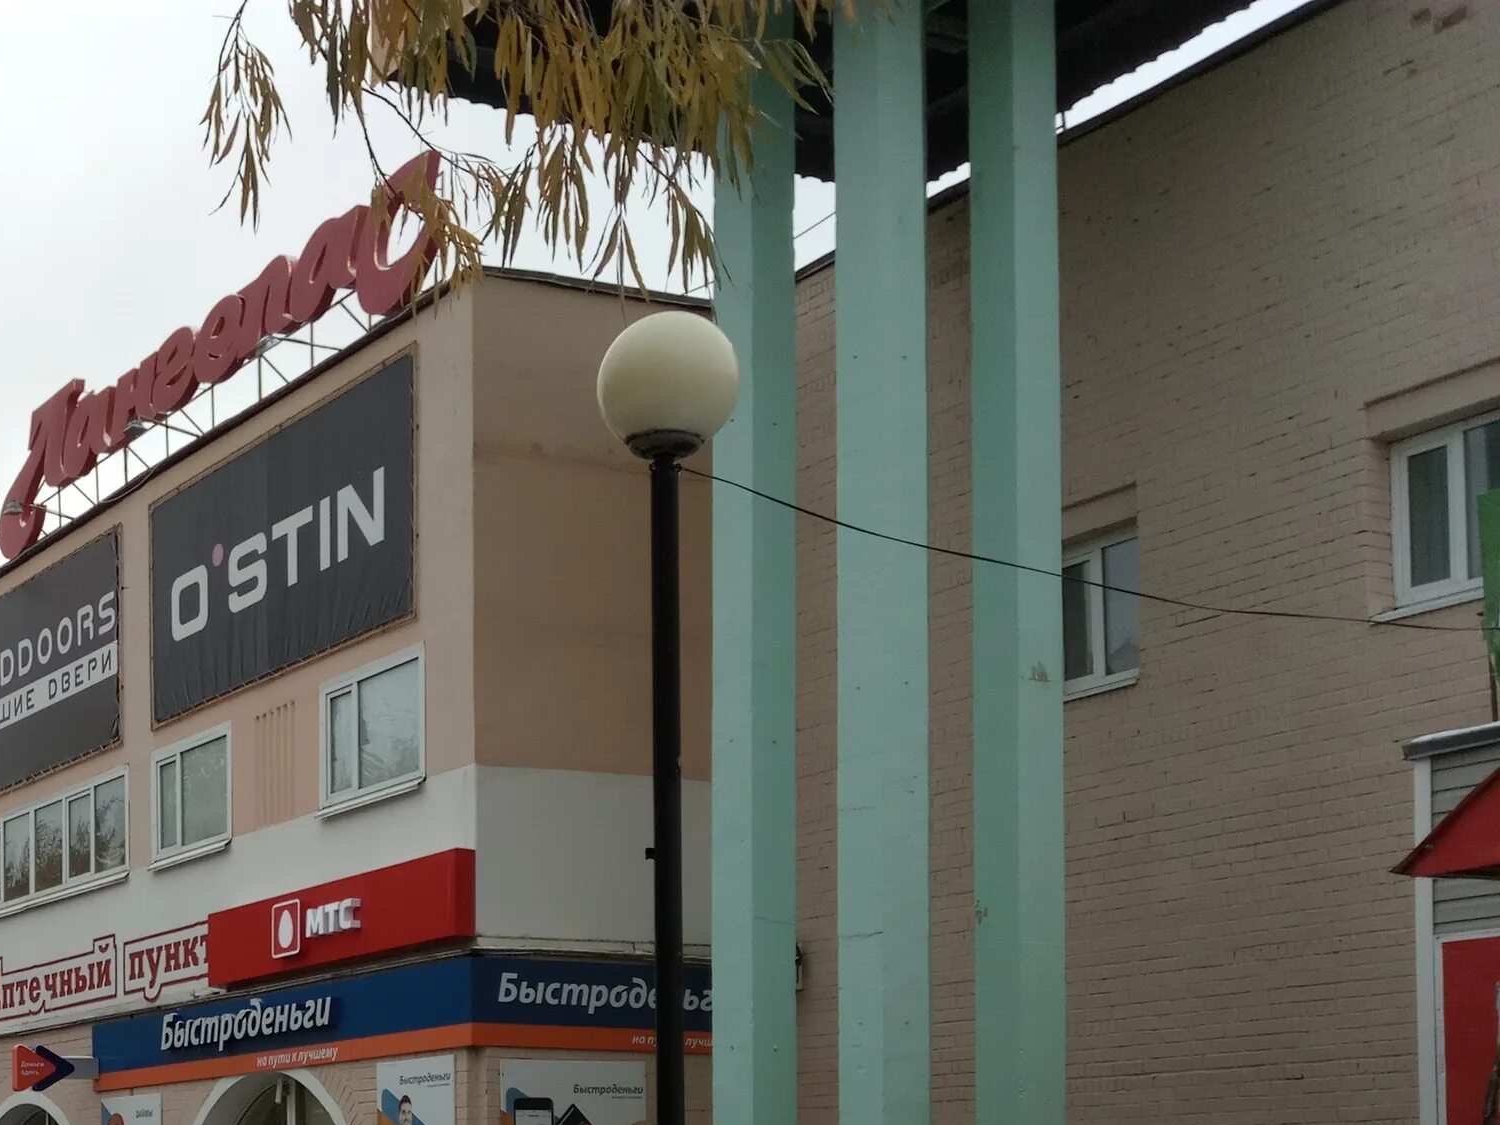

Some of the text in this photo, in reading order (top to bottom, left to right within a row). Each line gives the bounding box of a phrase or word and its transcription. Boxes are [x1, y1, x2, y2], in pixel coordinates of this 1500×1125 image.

[305, 898, 361, 938] МТС
[498, 971, 712, 1015] Быстродеьг
[161, 996, 332, 1051] Быстроденьги
[632, 1035, 645, 1044] на
[257, 1055, 267, 1067] на
[268, 1053, 290, 1069] пути
[298, 1047, 338, 1064] лучшему
[400, 1071, 451, 1087] Быстроденьги
[573, 1083, 644, 1097] Быстроденьги
